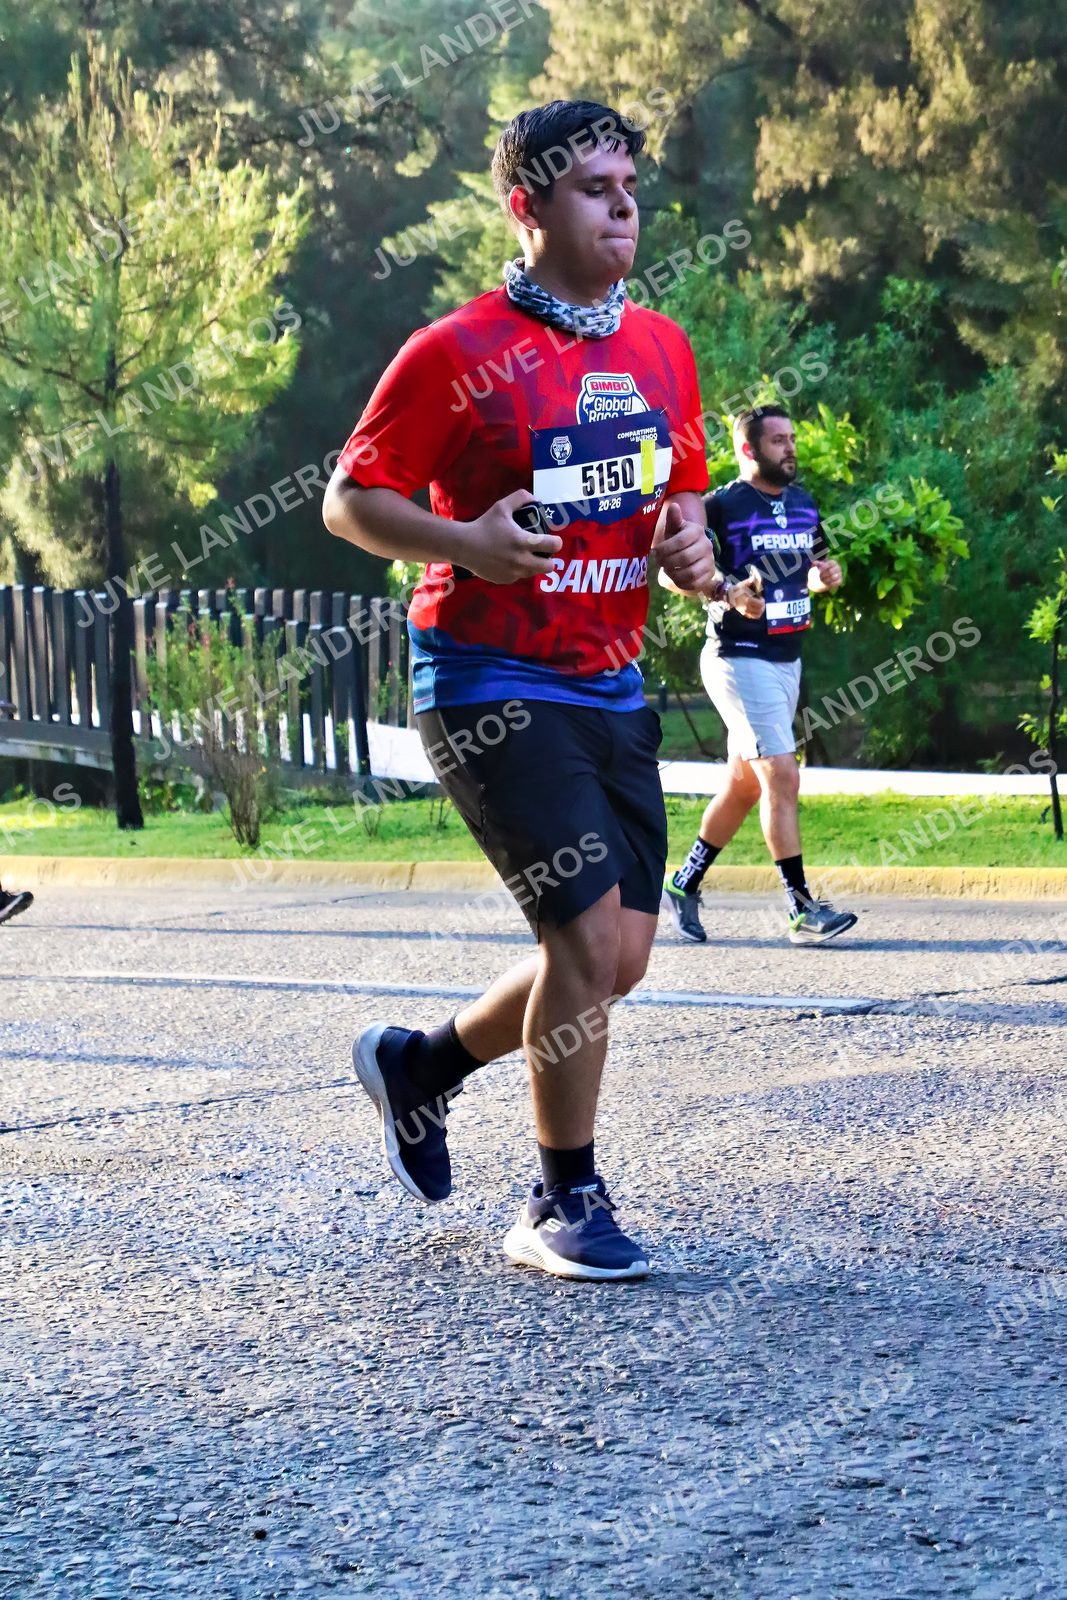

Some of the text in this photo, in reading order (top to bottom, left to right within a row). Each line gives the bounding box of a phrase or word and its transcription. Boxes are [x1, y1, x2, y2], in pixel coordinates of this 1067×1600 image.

[590, 381, 629, 391] BIMBO
[594, 396, 632, 412] Global
[581, 457, 635, 497] 5150
[642, 502, 657, 515] 10K
[539, 555, 648, 594] SANTIAG
